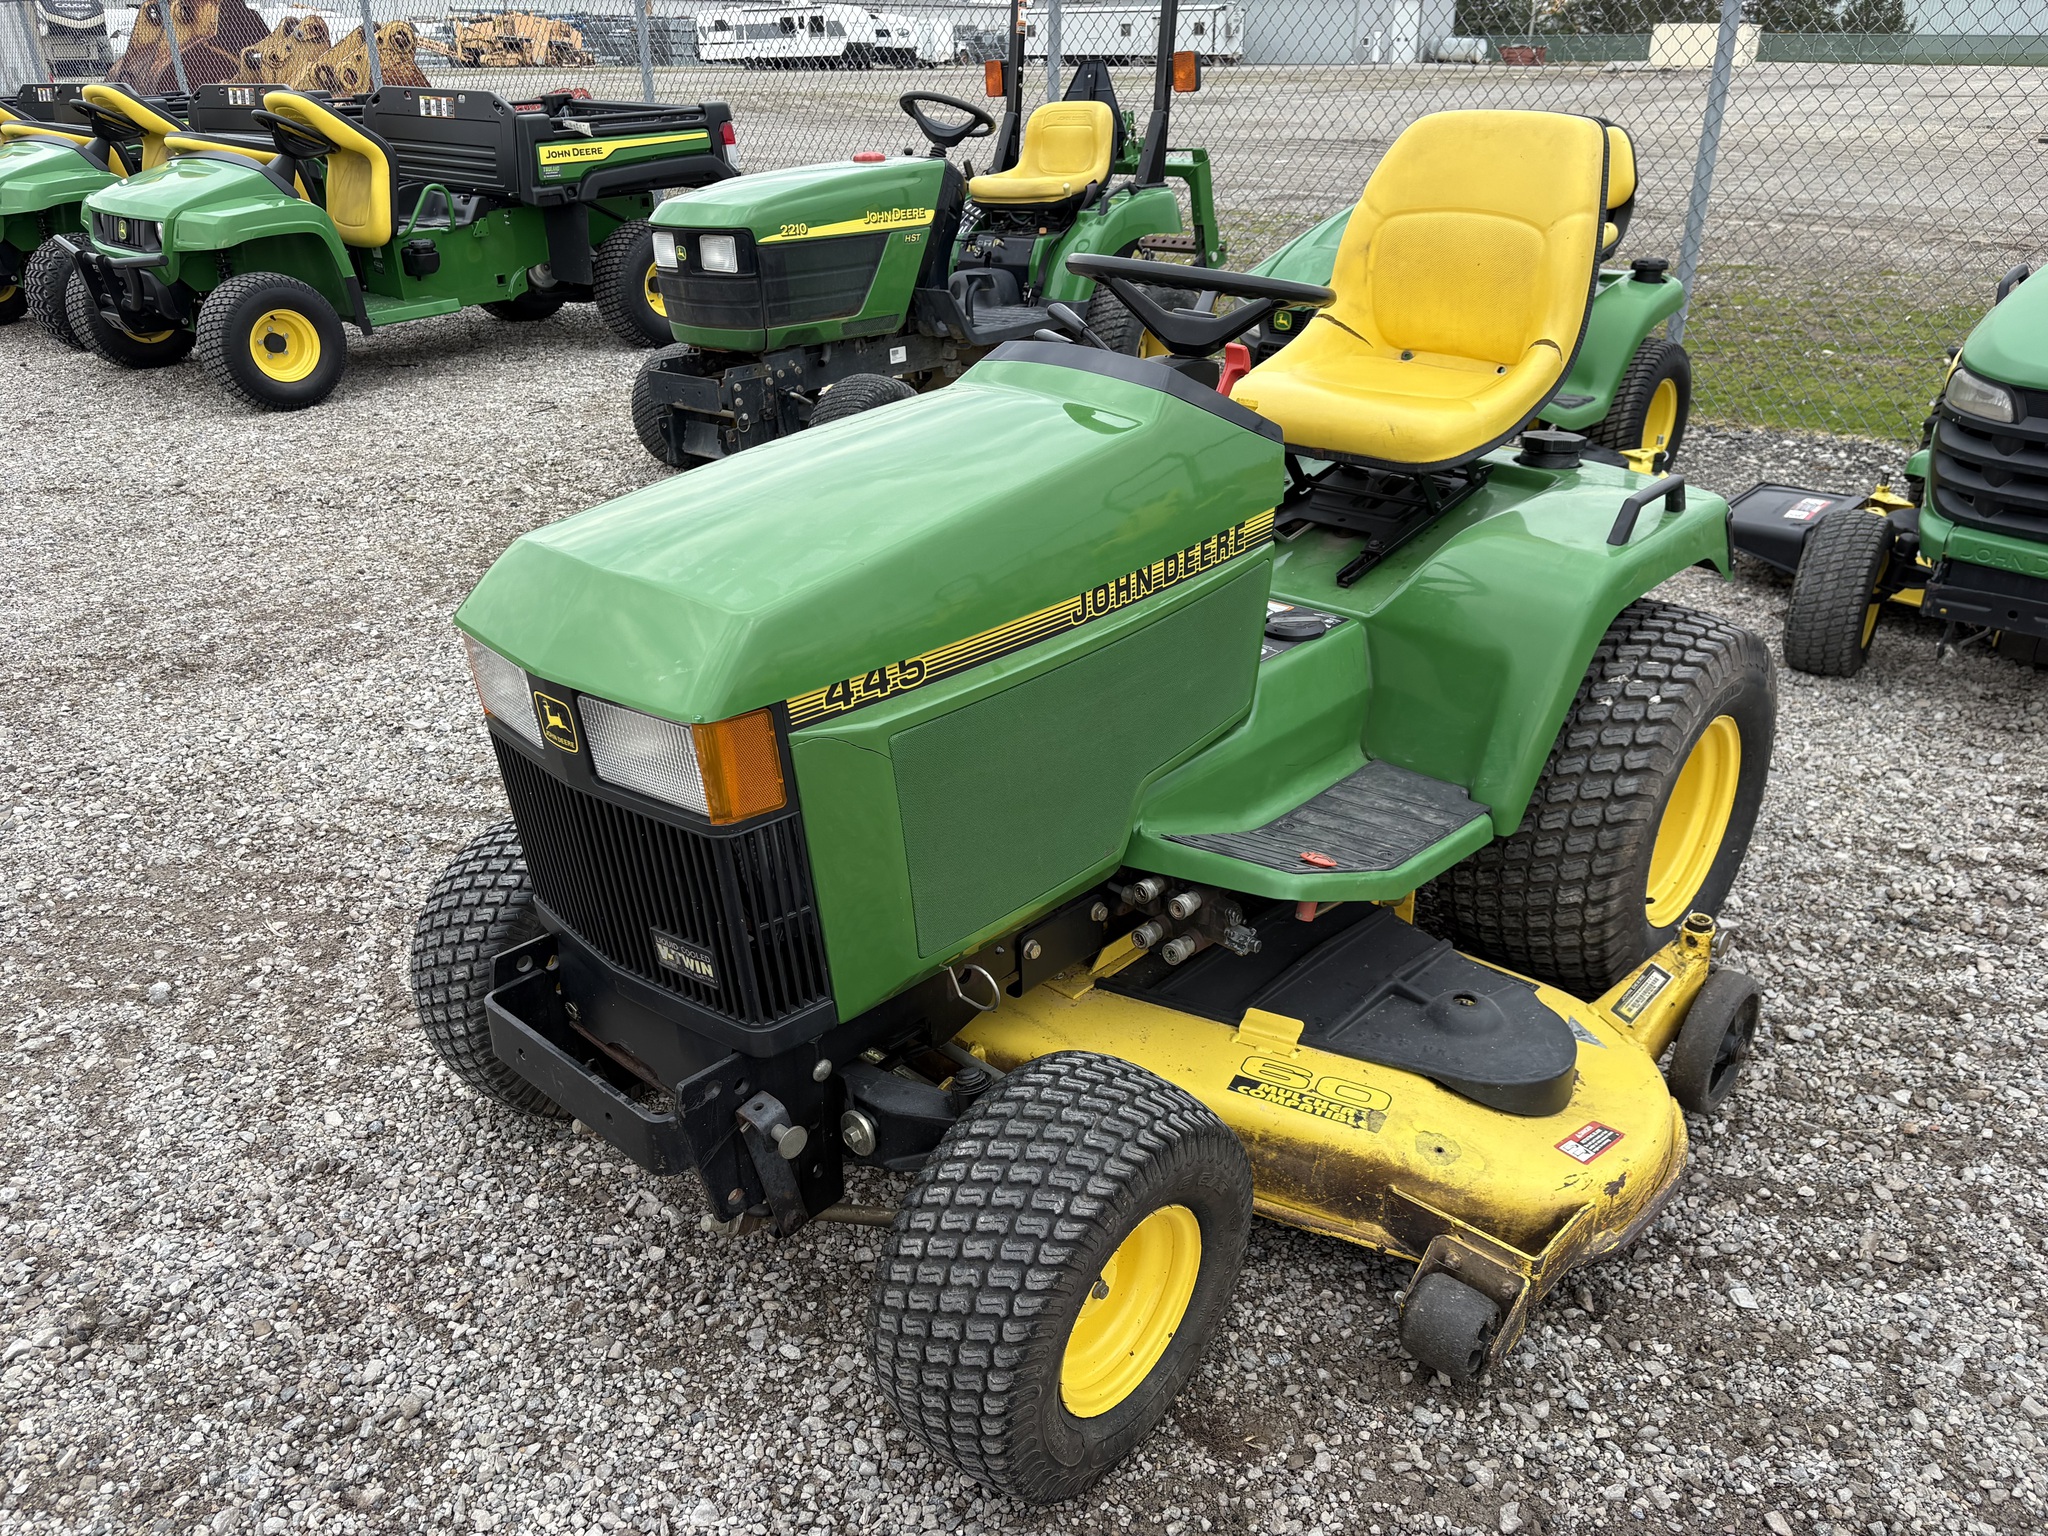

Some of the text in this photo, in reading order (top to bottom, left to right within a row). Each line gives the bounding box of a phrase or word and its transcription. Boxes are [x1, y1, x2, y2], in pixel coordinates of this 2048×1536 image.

[545, 146, 603, 159] JOHN DEERE
[780, 222, 809, 238] 2210
[864, 207, 926, 224] JOHN DEERE
[904, 233, 921, 243] HST
[1071, 520, 1247, 625] JOHN DEERE
[823, 655, 927, 710] 445
[655, 935, 711, 963] LIQUID COOLED
[655, 942, 714, 978] V-TWIN
[1240, 1055, 1393, 1111] 60
[1257, 1084, 1359, 1117] MULCHER
